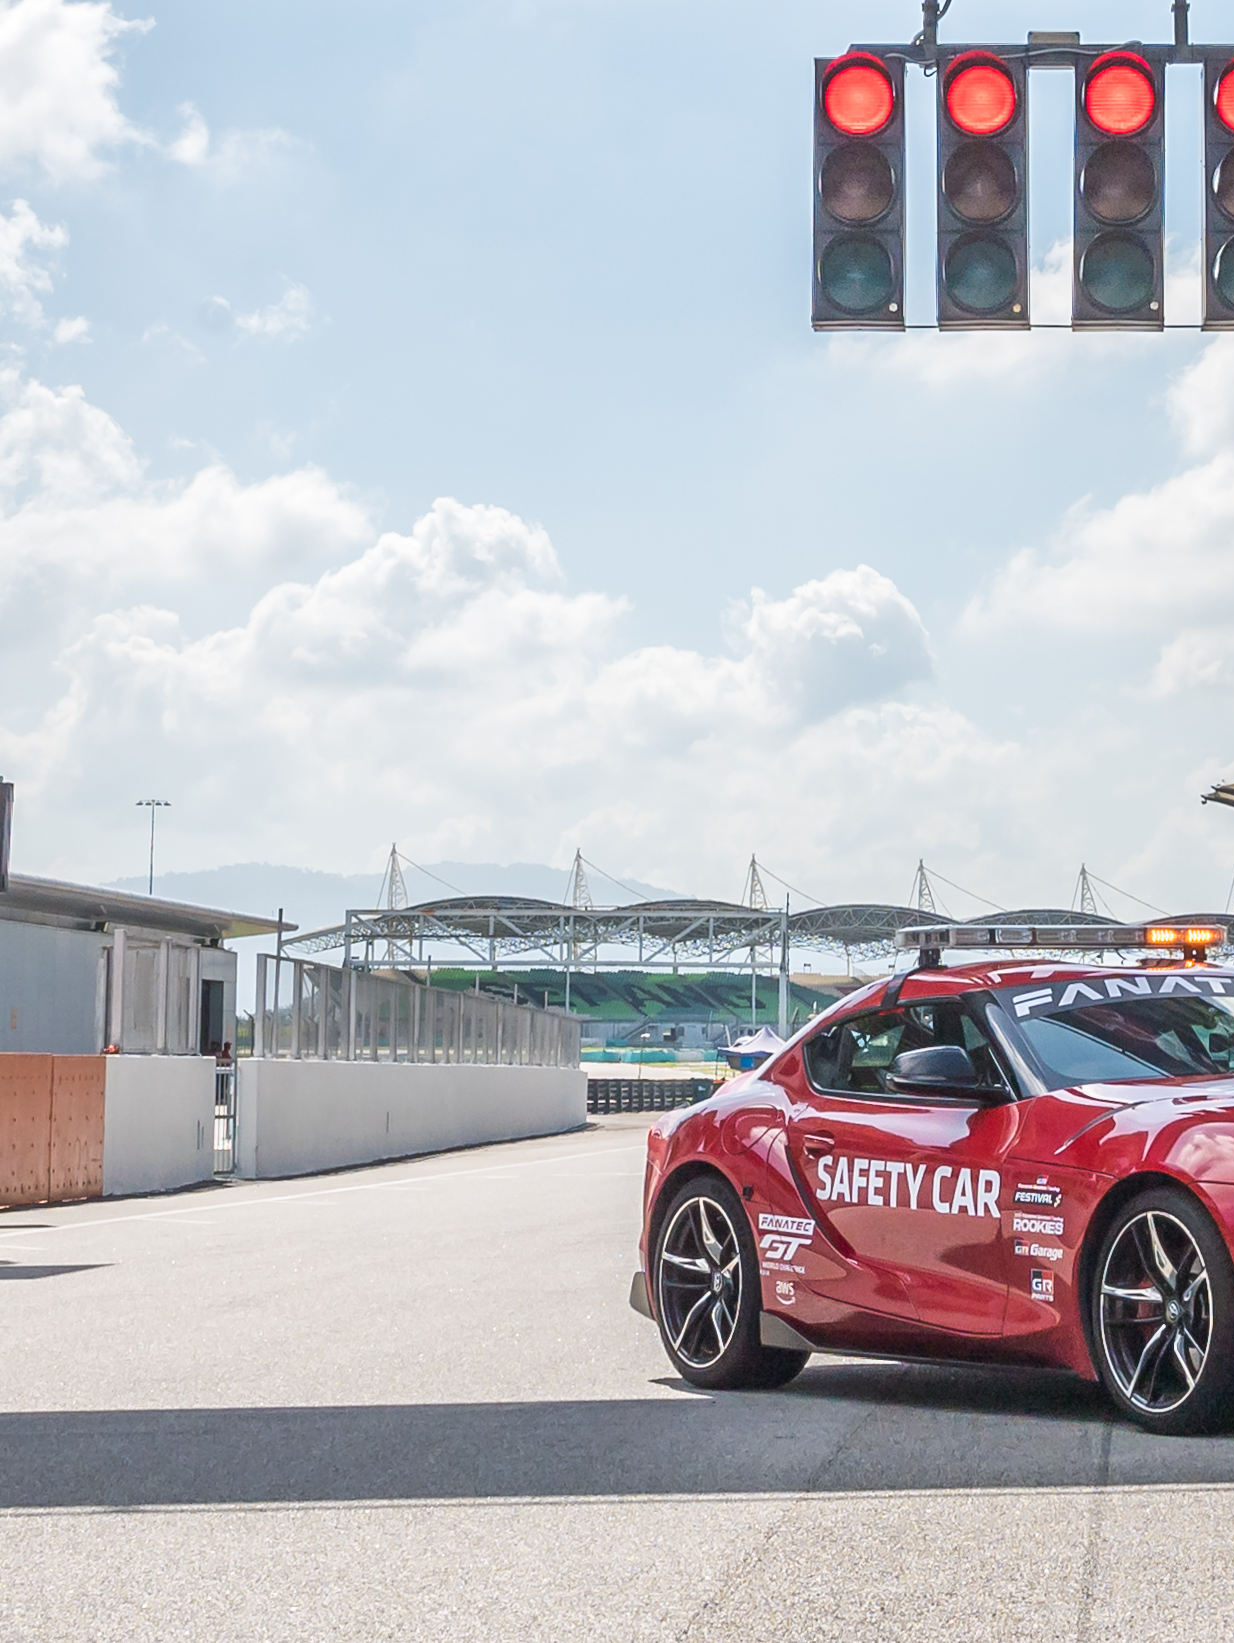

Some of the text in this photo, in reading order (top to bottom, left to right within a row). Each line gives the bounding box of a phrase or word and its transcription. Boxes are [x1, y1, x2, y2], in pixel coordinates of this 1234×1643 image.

[816, 1155, 1001, 1219] SAFETY CAR
[1015, 1191, 1053, 1204] FESTIVAL
[761, 1216, 812, 1232] FANATEC
[1013, 1218, 1064, 1235] ROOKIES
[1030, 1243, 1063, 1261] Garage
[776, 1281, 795, 1296] aws
[1032, 1278, 1053, 1293] GR
